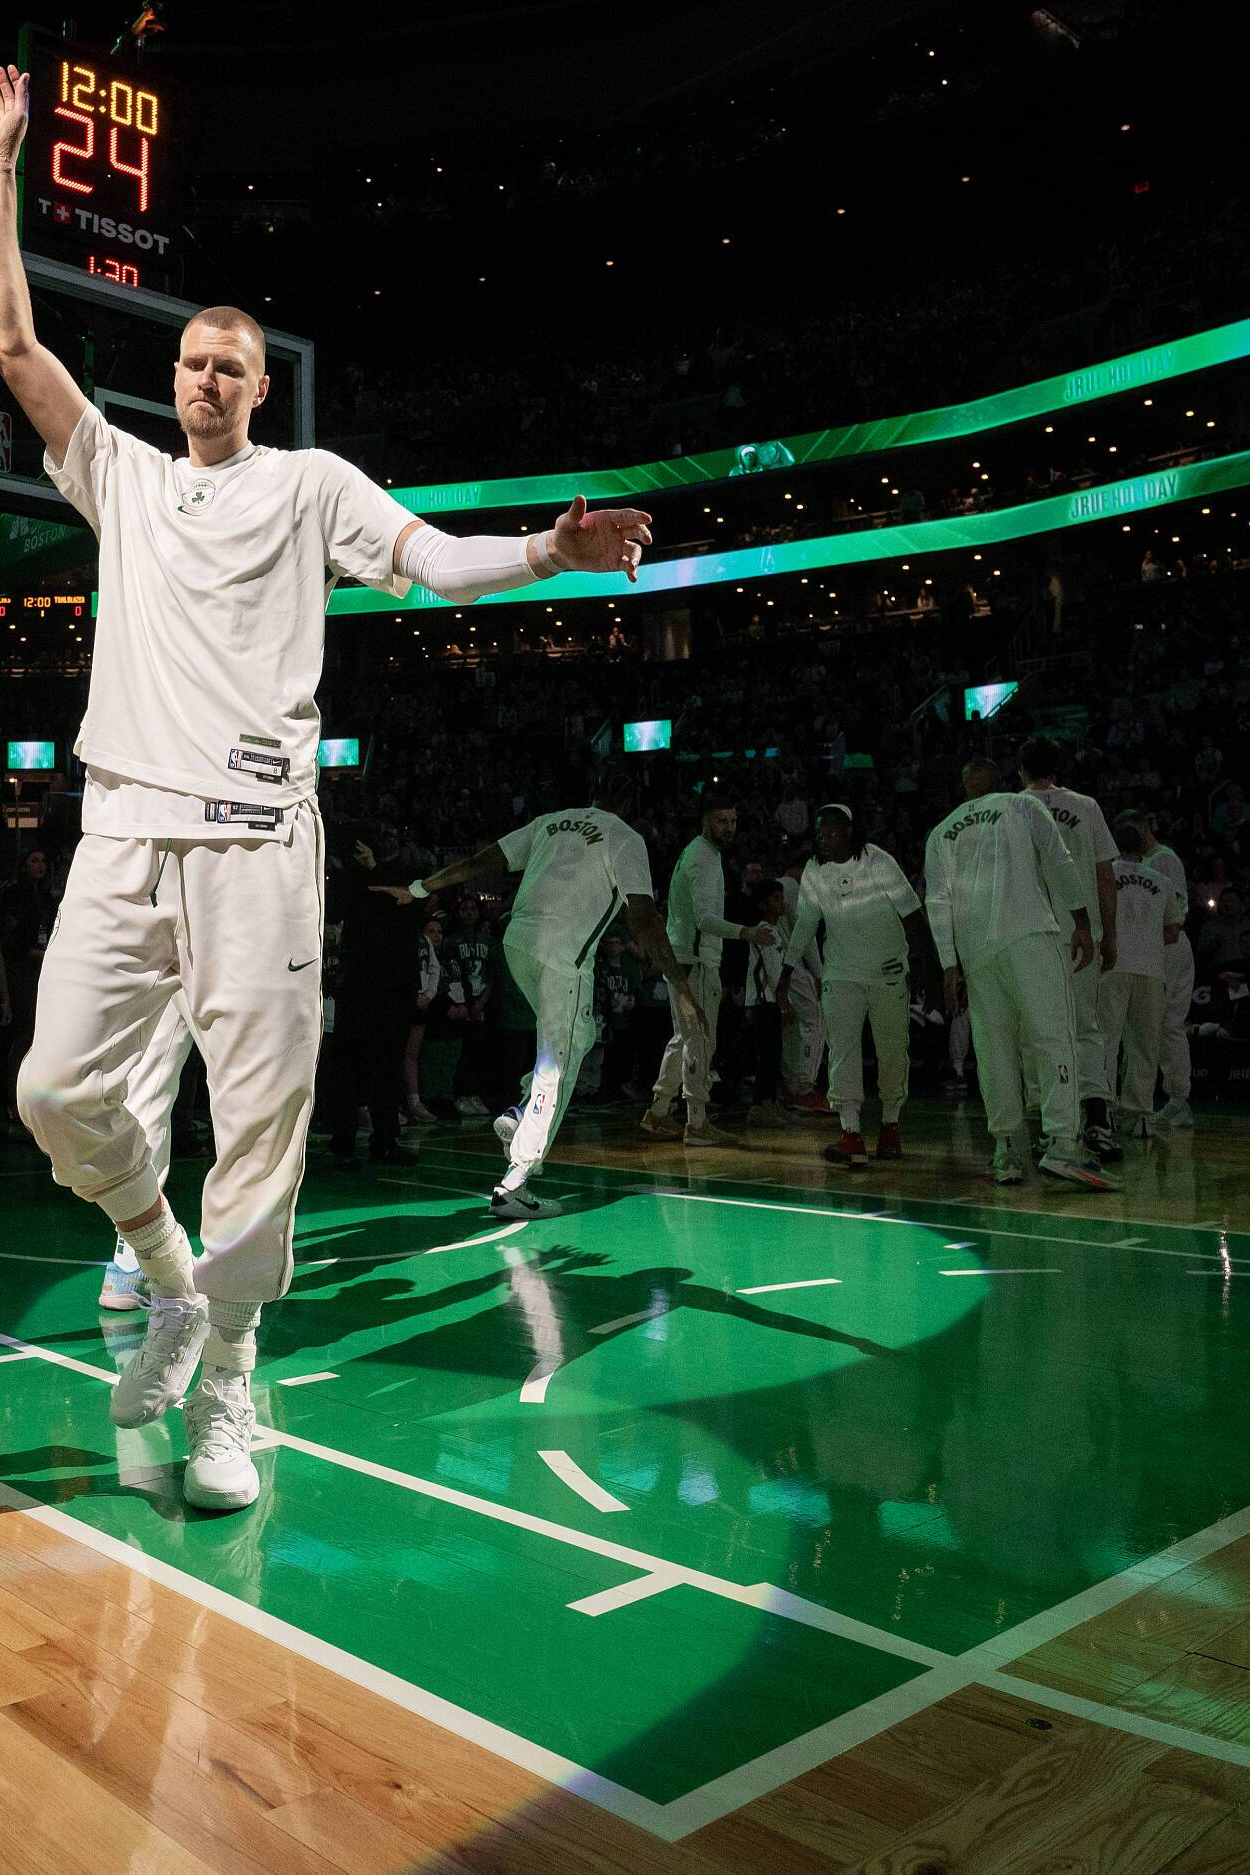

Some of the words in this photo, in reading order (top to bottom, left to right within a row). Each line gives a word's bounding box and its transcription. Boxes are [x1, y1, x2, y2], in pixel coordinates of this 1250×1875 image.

[61, 61, 158, 136] 12:00
[52, 107, 149, 213] 24
[75, 208, 170, 255] TISSOT
[23, 525, 66, 553] BOSTON
[24, 597, 51, 608] 12:00
[546, 820, 603, 845] BOSTON
[943, 809, 1003, 842] BOSTON
